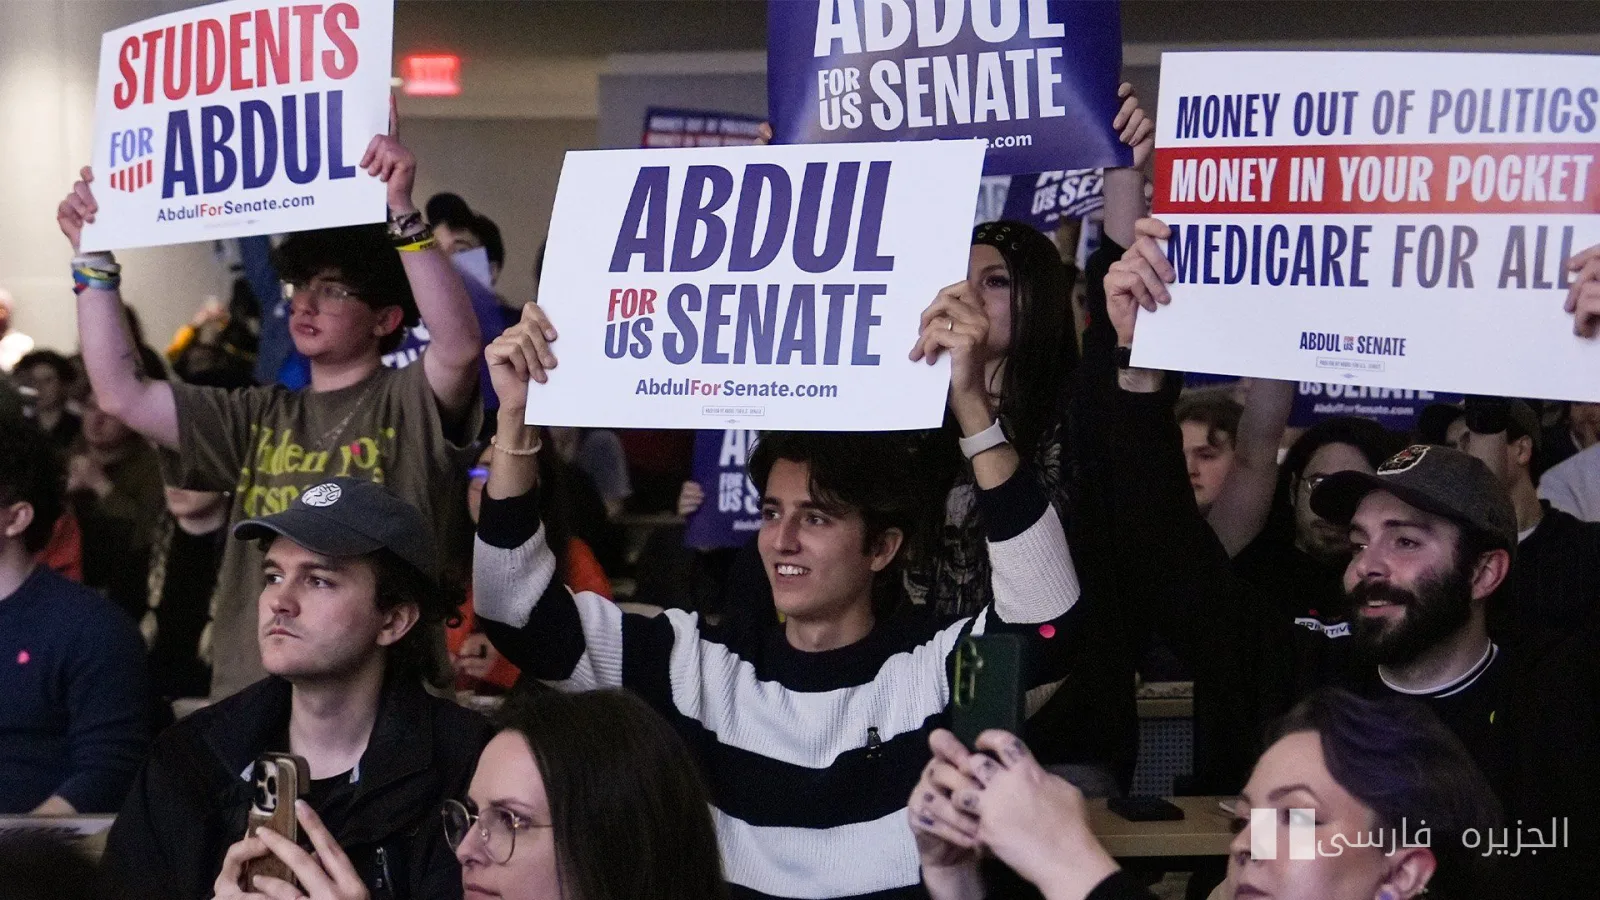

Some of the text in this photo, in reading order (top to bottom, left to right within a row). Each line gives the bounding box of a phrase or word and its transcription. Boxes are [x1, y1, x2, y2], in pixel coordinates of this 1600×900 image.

[113, 3, 361, 110] STUDENTS
[818, 67, 861, 100] FOR
[819, 47, 1066, 131] US SENATE
[1175, 87, 1598, 139] MONEY OUT OF POLITICS
[109, 90, 357, 199] FOR ABDUL
[1169, 154, 1593, 203] MONEY IN YOUR POCKET
[156, 194, 316, 223] AbdulForSenate.com
[608, 160, 896, 273] ABDUL
[1168, 224, 1576, 290] MEDICARE FOR ALL
[604, 282, 888, 366] US SENATE
[607, 288, 658, 321] FOR
[1300, 331, 1341, 352] ABDUL
[1357, 335, 1406, 357] SENATE
[635, 378, 838, 398] AbdulForSenate.com
